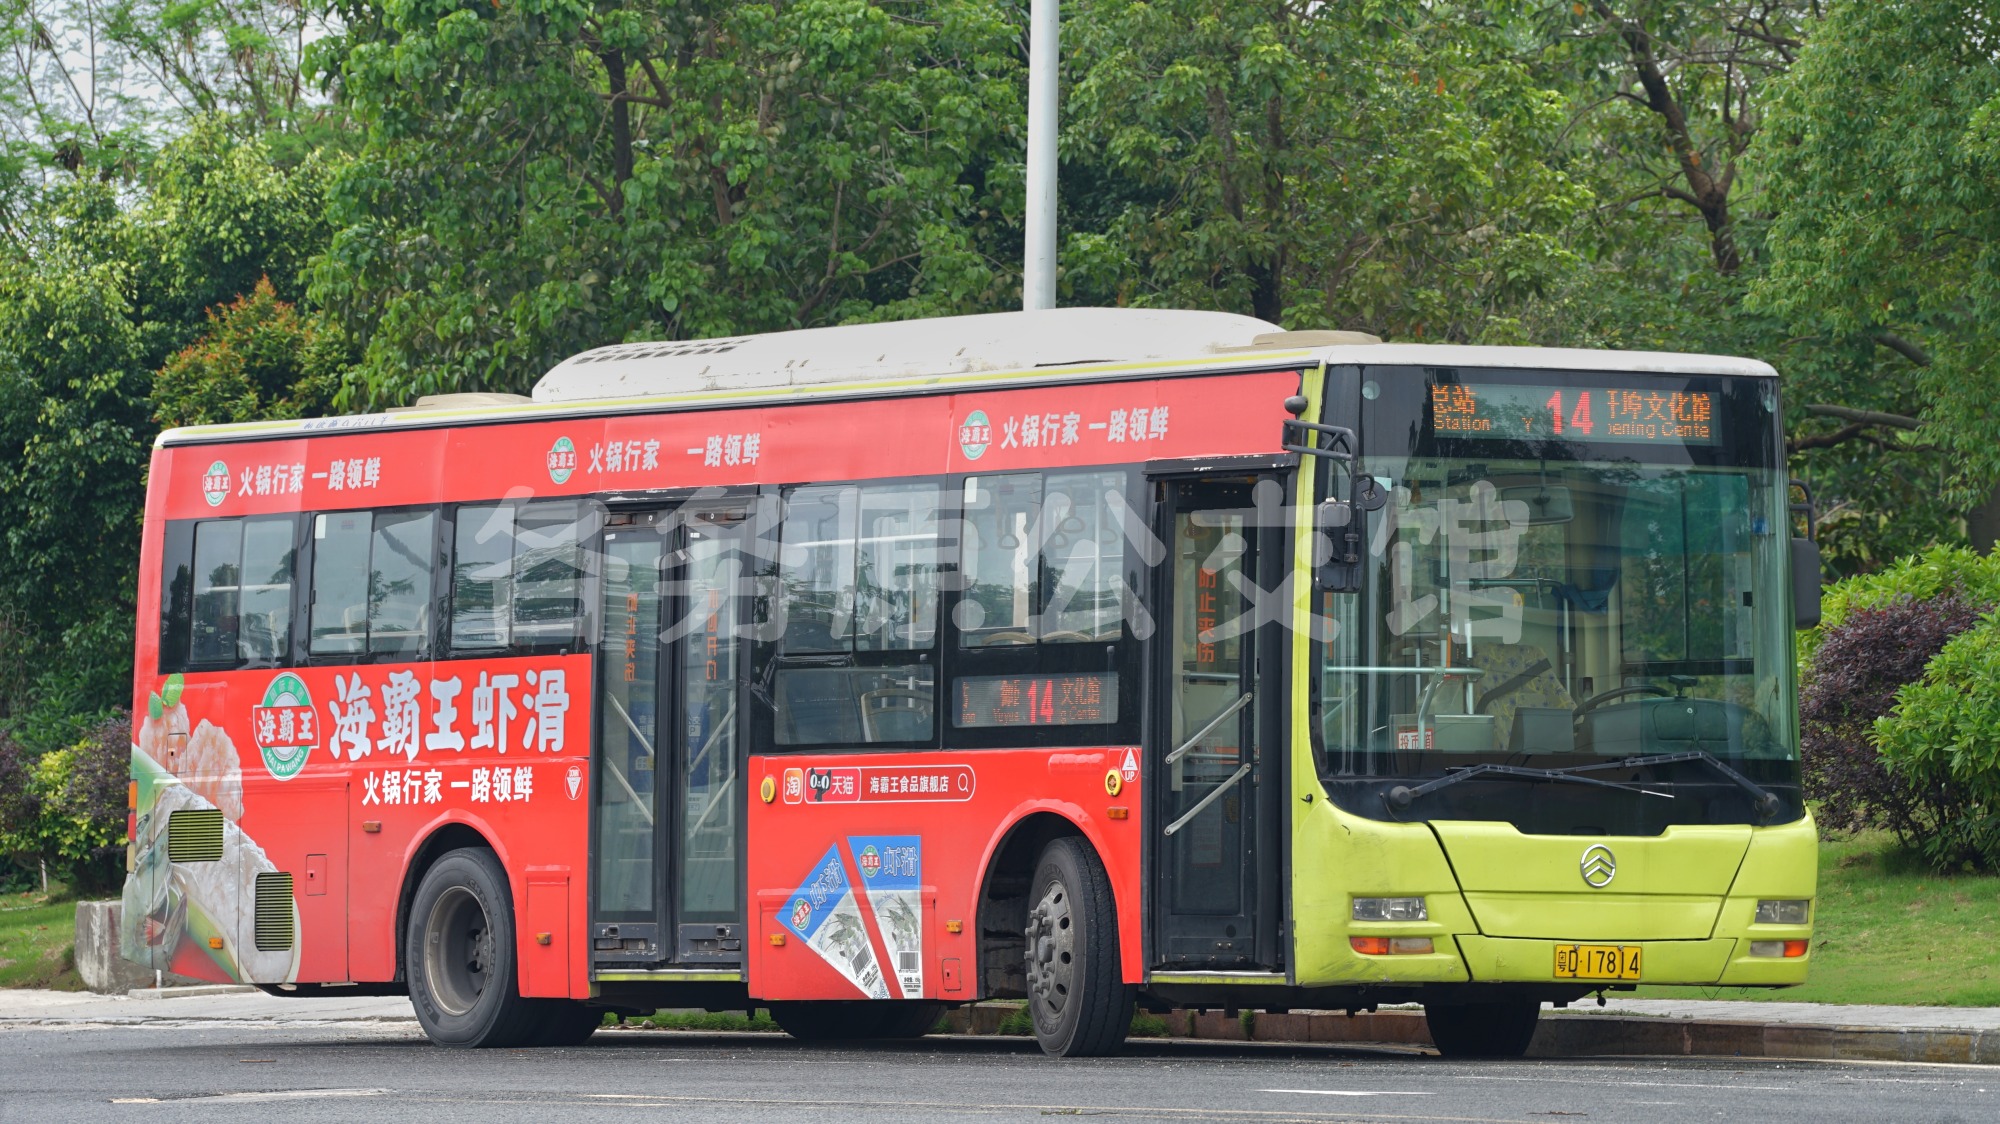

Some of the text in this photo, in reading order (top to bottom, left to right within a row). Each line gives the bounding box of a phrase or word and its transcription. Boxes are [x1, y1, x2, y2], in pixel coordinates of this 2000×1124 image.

[1001, 406, 1169, 449] 火锅行家 一路领鲜
[1434, 415, 1491, 431] Station
[1546, 390, 1594, 435] 14
[961, 427, 989, 444] 海霸王
[550, 452, 575, 469] 海霸王
[587, 433, 760, 474] 火锅行家 一路领鲜
[238, 457, 381, 497] 火锅行家 一路领鲜
[329, 669, 569, 762] 海霸王虾滑
[1027, 680, 1054, 723] 14
[258, 709, 314, 744] 海霸王
[362, 766, 533, 806] 火锅行家 一路领鲜
[786, 776, 800, 796] 淘
[832, 776, 854, 795] 天猫
[870, 775, 949, 793] 海霸王食品旗舰店
[1124, 770, 1135, 780] UP
[884, 846, 918, 877] 虾滑
[809, 858, 843, 910] 虾滑
